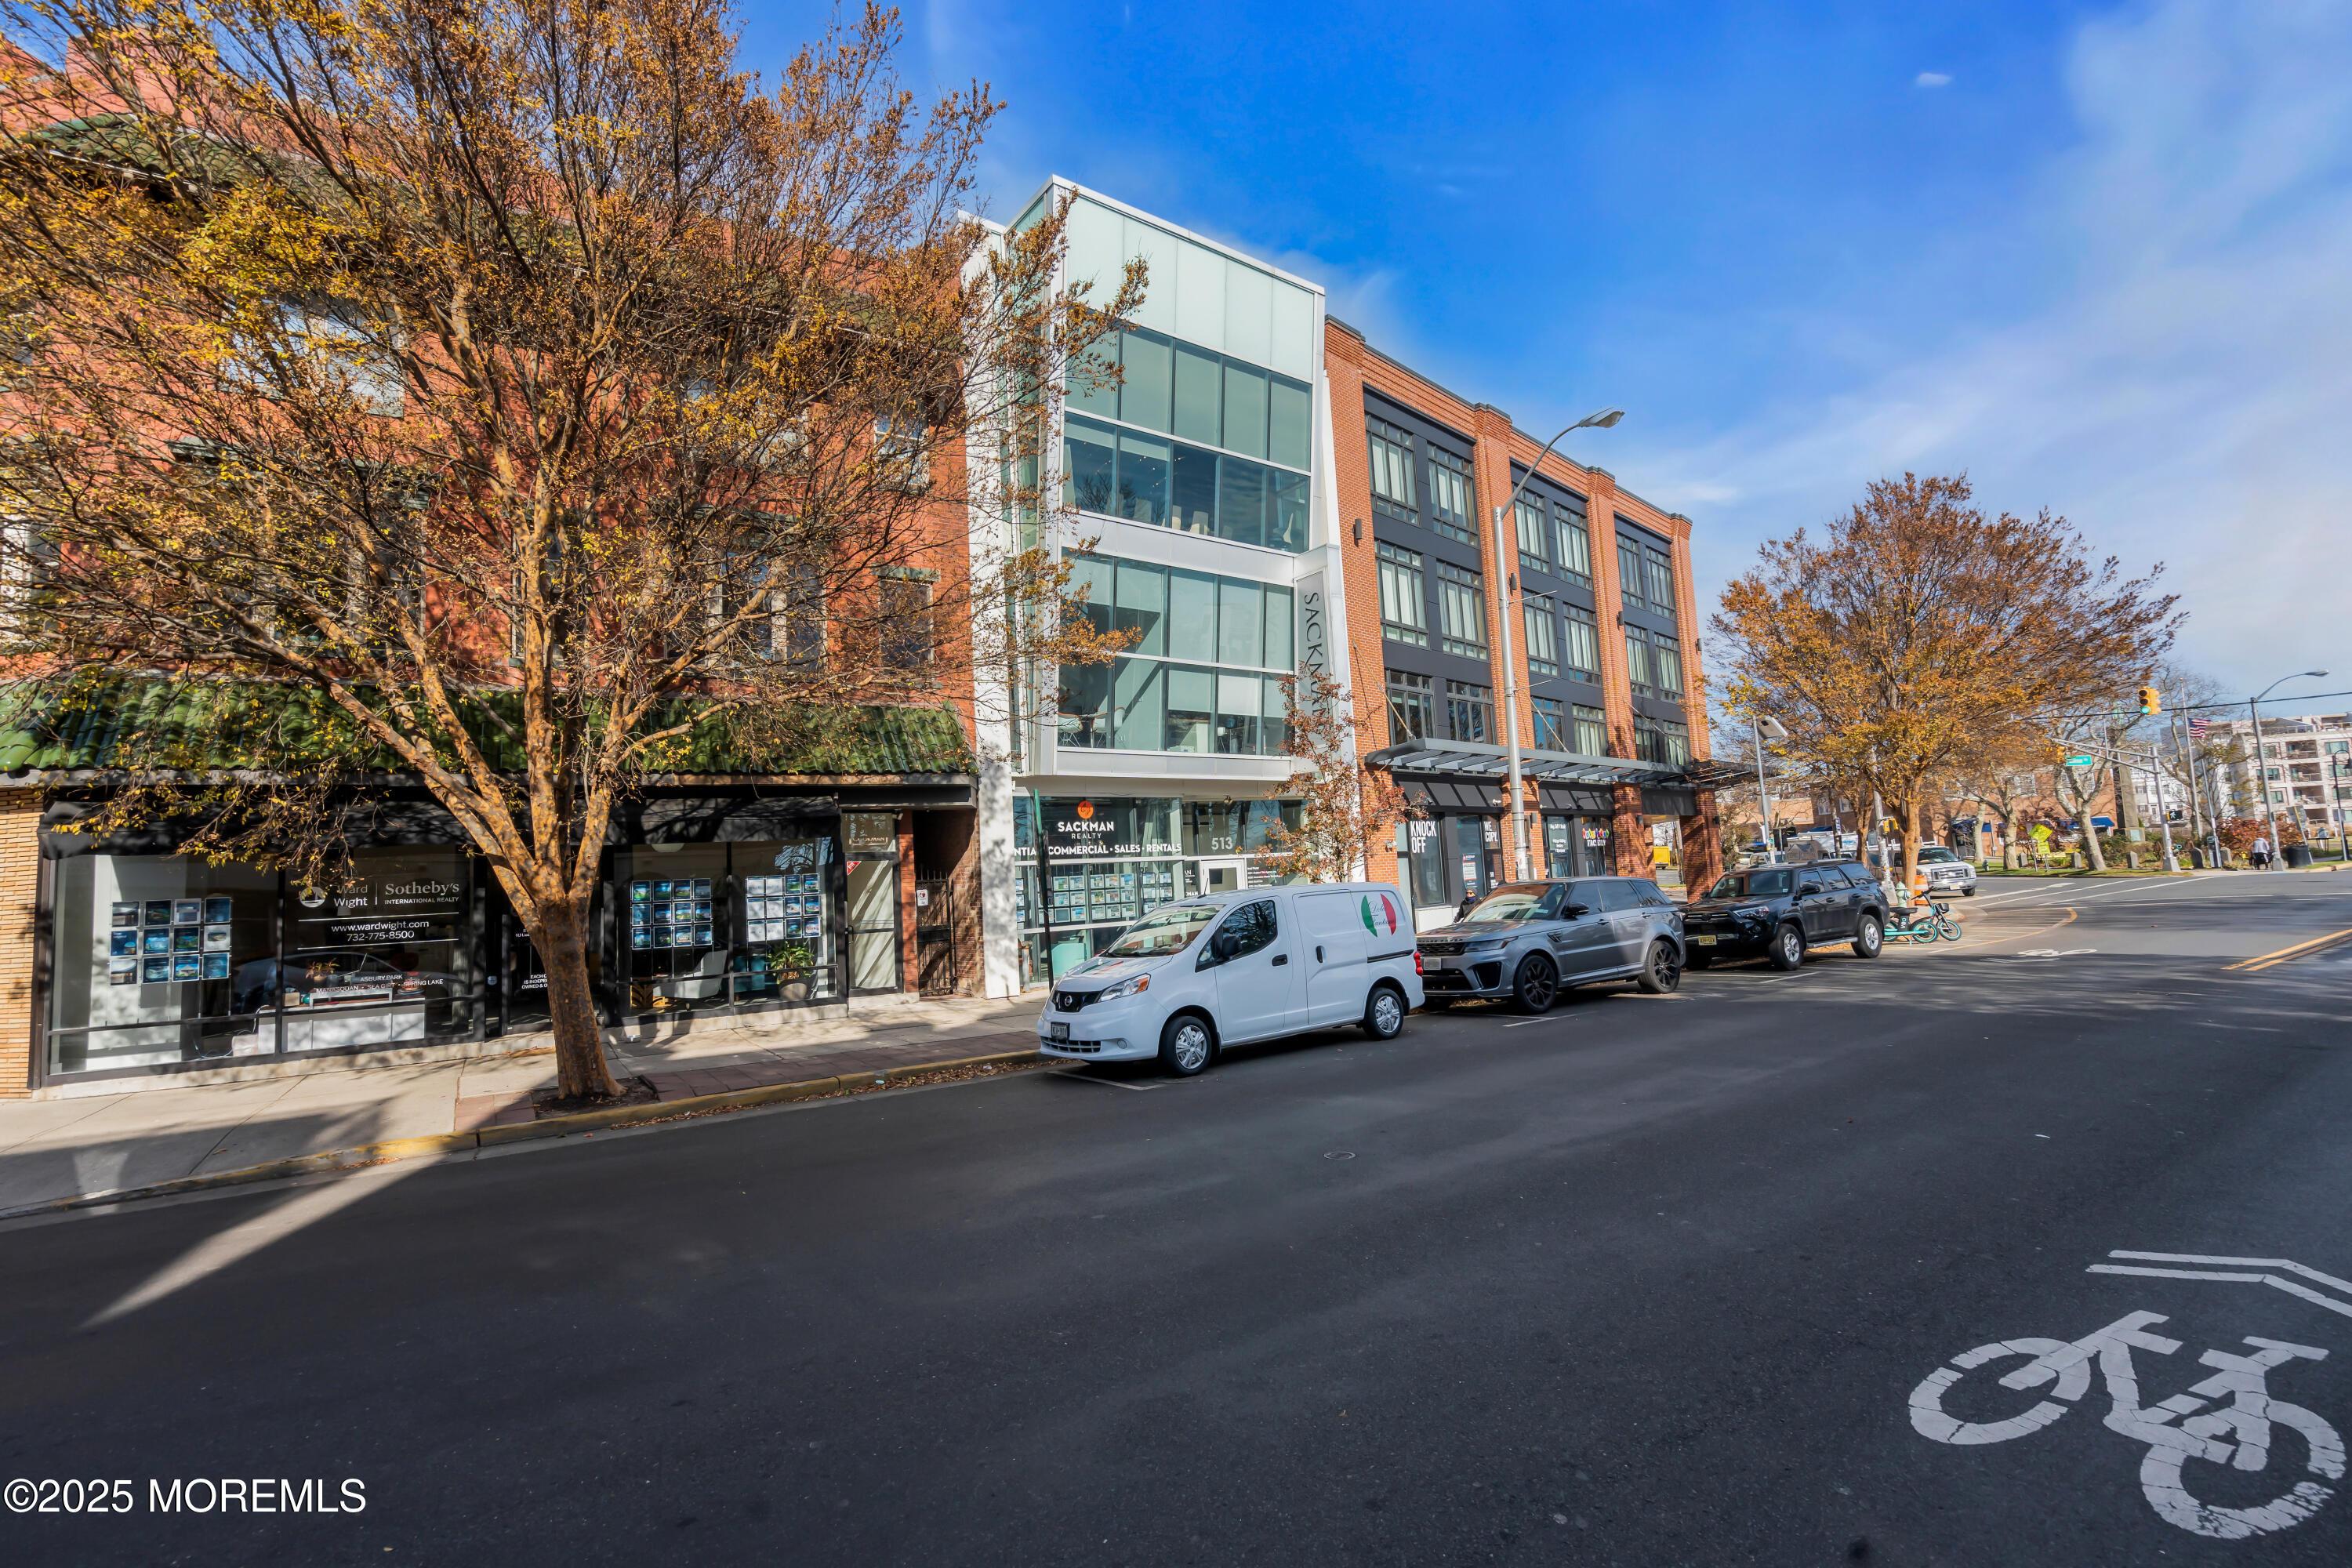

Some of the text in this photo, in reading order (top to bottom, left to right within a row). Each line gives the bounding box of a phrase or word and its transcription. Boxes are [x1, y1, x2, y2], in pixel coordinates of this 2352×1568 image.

[1058, 821, 1114, 832] SACKMAN
[1410, 821, 1436, 837] KNOCK
[1484, 822, 1492, 831] WE
[1048, 844, 1109, 855] COMMERCIAL
[1115, 844, 1141, 853] SALES
[1146, 843, 1182, 853] RENTALS
[1211, 837, 1233, 851] 513
[1412, 837, 1426, 853] OFF
[337, 884, 368, 895] Ward
[385, 880, 459, 896] Sotheby's
[334, 896, 368, 909] Wight
[331, 920, 430, 932] www.wardwight.com
[347, 930, 415, 942] 732-775-8500
